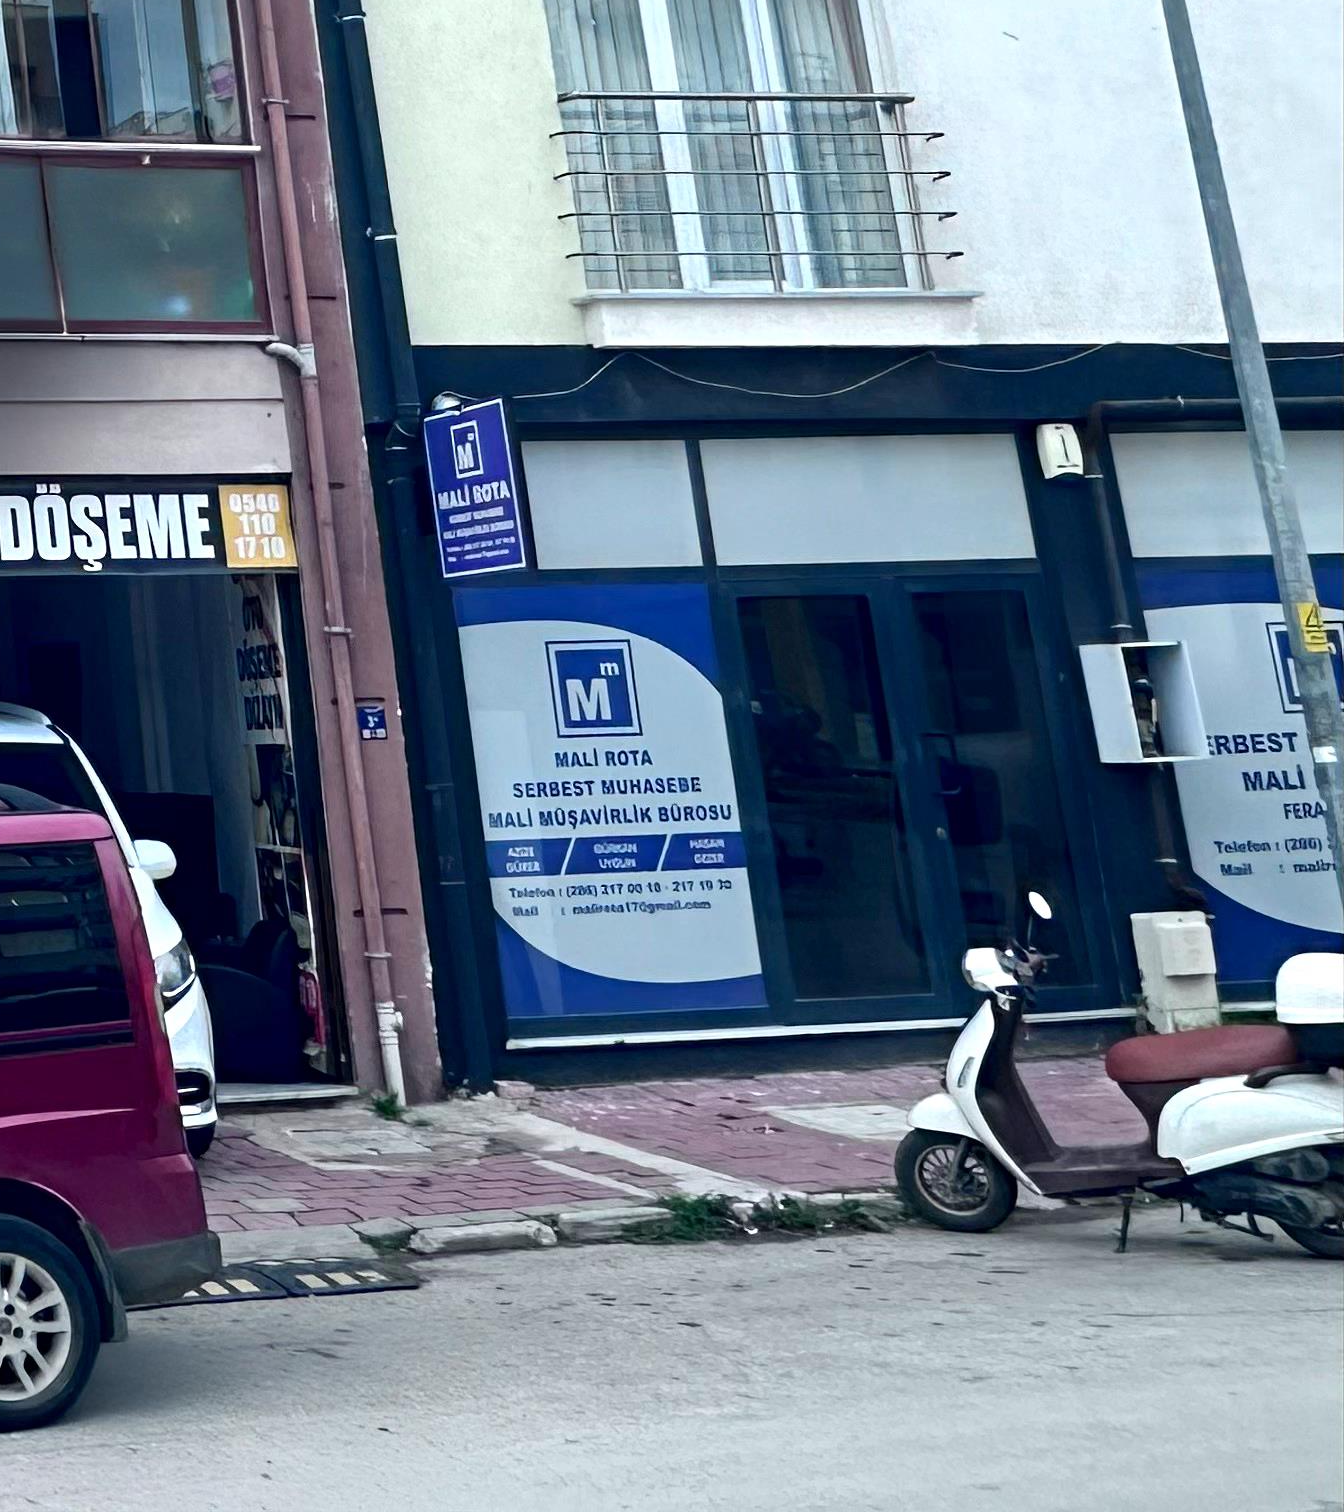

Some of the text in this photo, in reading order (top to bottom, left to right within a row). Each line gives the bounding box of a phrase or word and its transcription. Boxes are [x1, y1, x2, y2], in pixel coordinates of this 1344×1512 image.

[437, 482, 471, 510] MALİ
[238, 511, 277, 536] 110
[234, 535, 287, 560] 17 10
[1206, 731, 1298, 756] RBEST
[554, 747, 654, 768] MALİ ROTA
[512, 776, 703, 798] SERBEST MUHASEBE
[1241, 764, 1306, 792] MALİ
[488, 803, 733, 830] MALİ MÜŞAVİRLİK BÜROSU
[1214, 840, 1272, 854] Telefon
